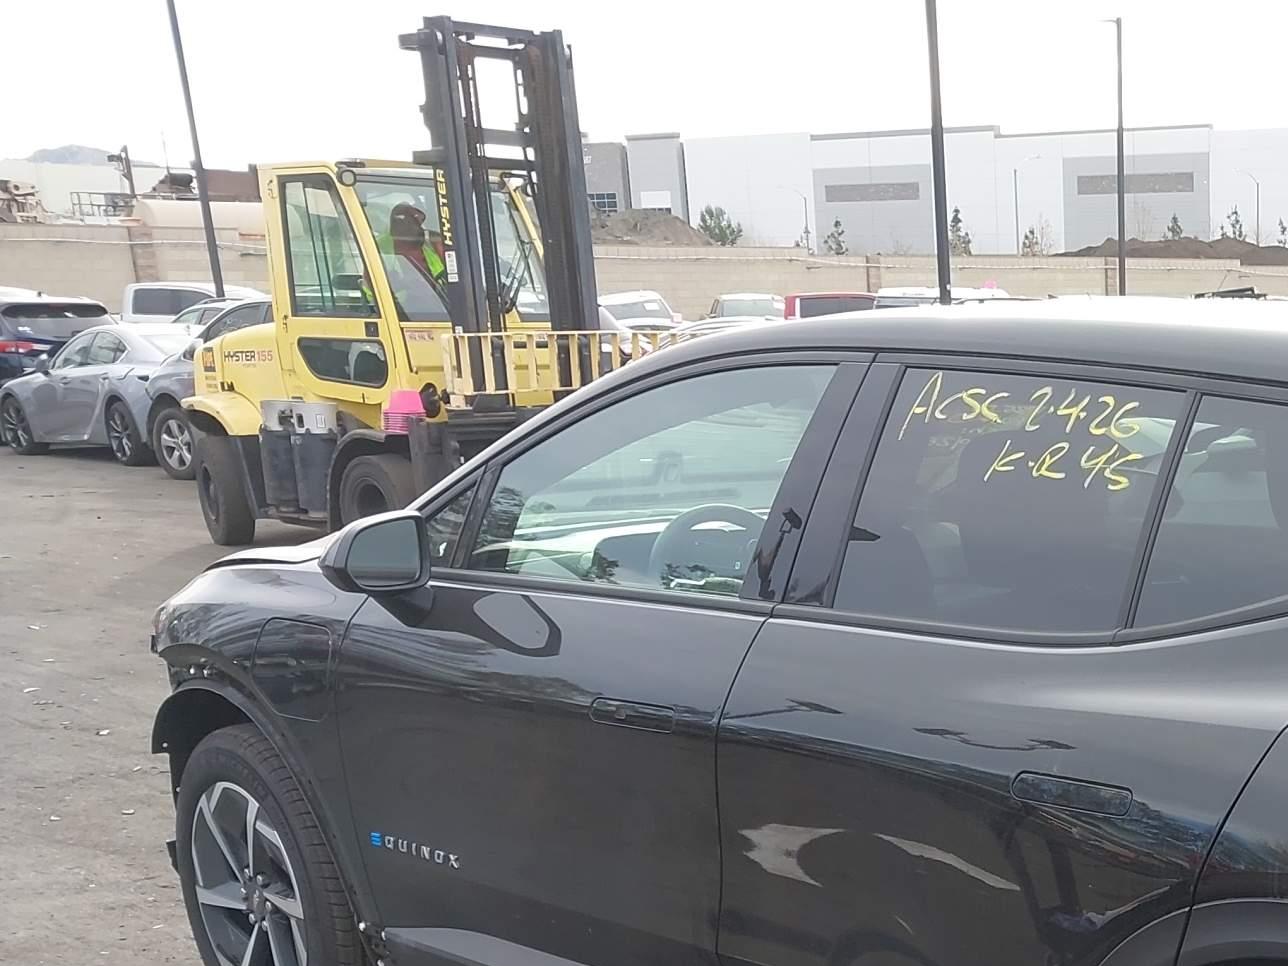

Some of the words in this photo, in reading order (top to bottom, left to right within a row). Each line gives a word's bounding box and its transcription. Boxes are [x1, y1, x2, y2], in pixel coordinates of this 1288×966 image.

[435, 168, 453, 247] HYSTER
[223, 350, 256, 362] HYSTER
[257, 350, 273, 362] 155
[370, 831, 460, 869] EQUINOX
